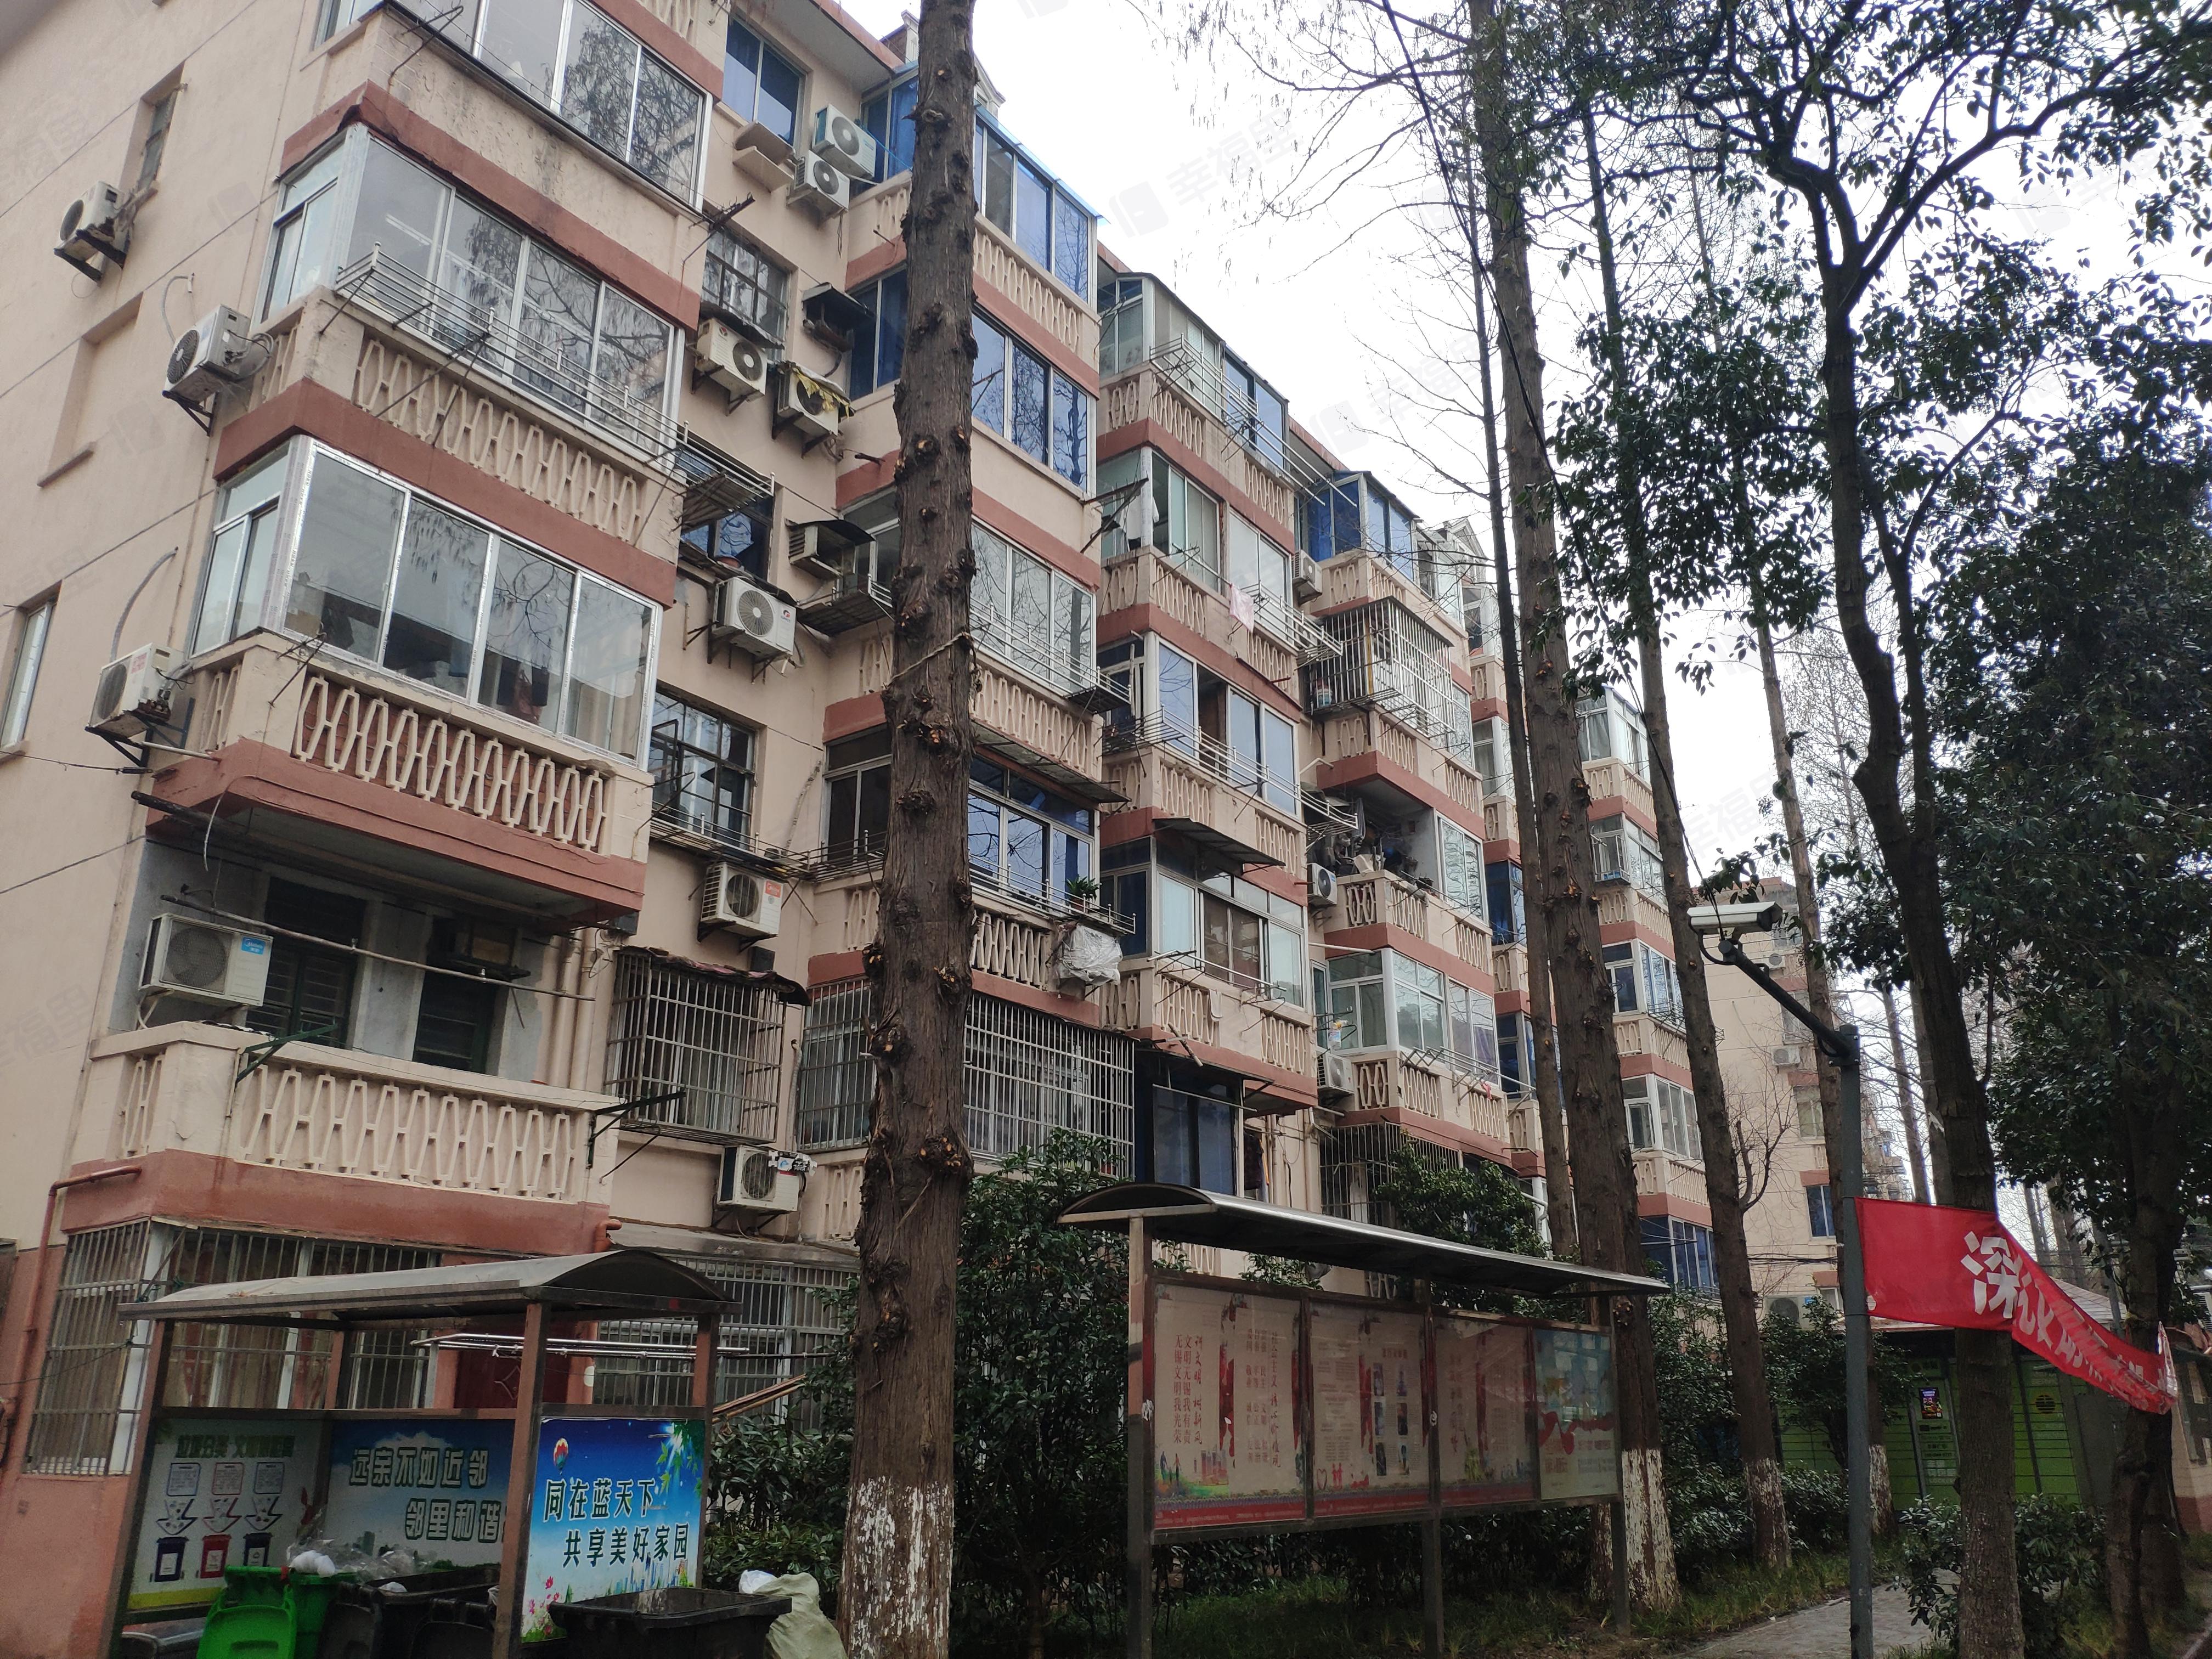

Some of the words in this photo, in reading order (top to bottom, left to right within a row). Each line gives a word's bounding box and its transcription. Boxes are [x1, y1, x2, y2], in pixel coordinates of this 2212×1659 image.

[1173, 1334, 1182, 1443] 无锡文明我光荣
[1183, 1334, 1192, 1444] 文明无锡我有责
[349, 1447, 488, 1488] 远亲不如近邻
[405, 1498, 506, 1543] 邻里和谐
[543, 1477, 656, 1522] 同在蓝天下
[562, 1521, 690, 1570] 共享美好家园
